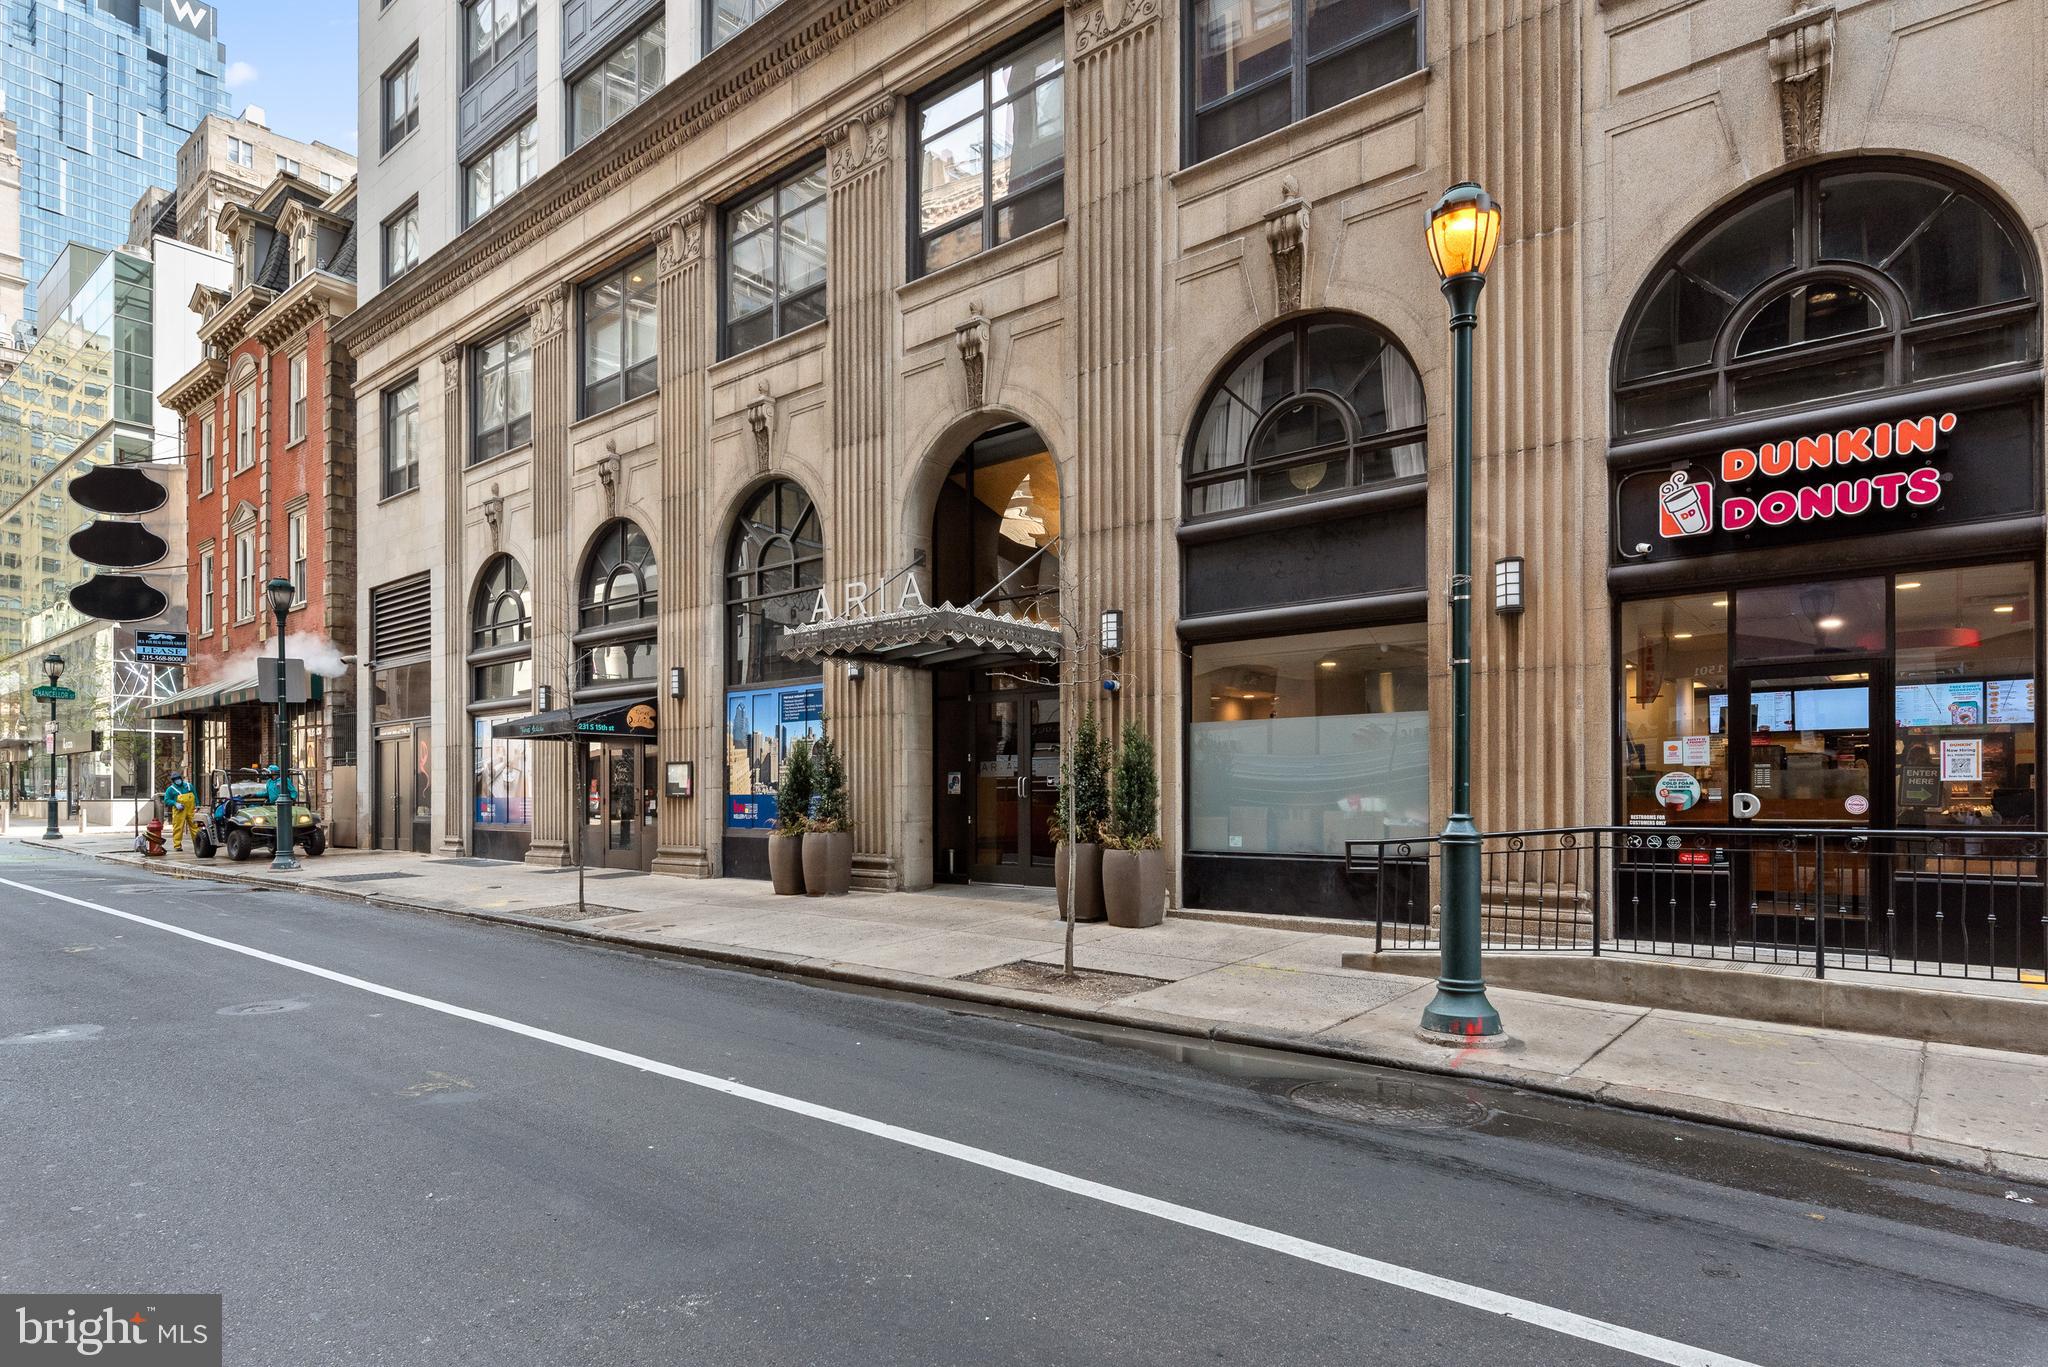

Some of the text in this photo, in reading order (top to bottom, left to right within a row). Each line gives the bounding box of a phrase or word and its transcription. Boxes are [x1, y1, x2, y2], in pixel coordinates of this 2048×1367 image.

[171, 0, 207, 29] W
[1722, 412, 1957, 482] DUNKIN'
[1722, 468, 1941, 530] DONUTS
[811, 572, 925, 623] ARIA
[874, 616, 928, 638] STREET
[141, 654, 184, 662] 215-568-8000
[142, 647, 184, 655] LEASE
[34, 689, 69, 699] CHANCELLOR
[1906, 769, 1938, 777] ENTER
[1733, 792, 1761, 818] D
